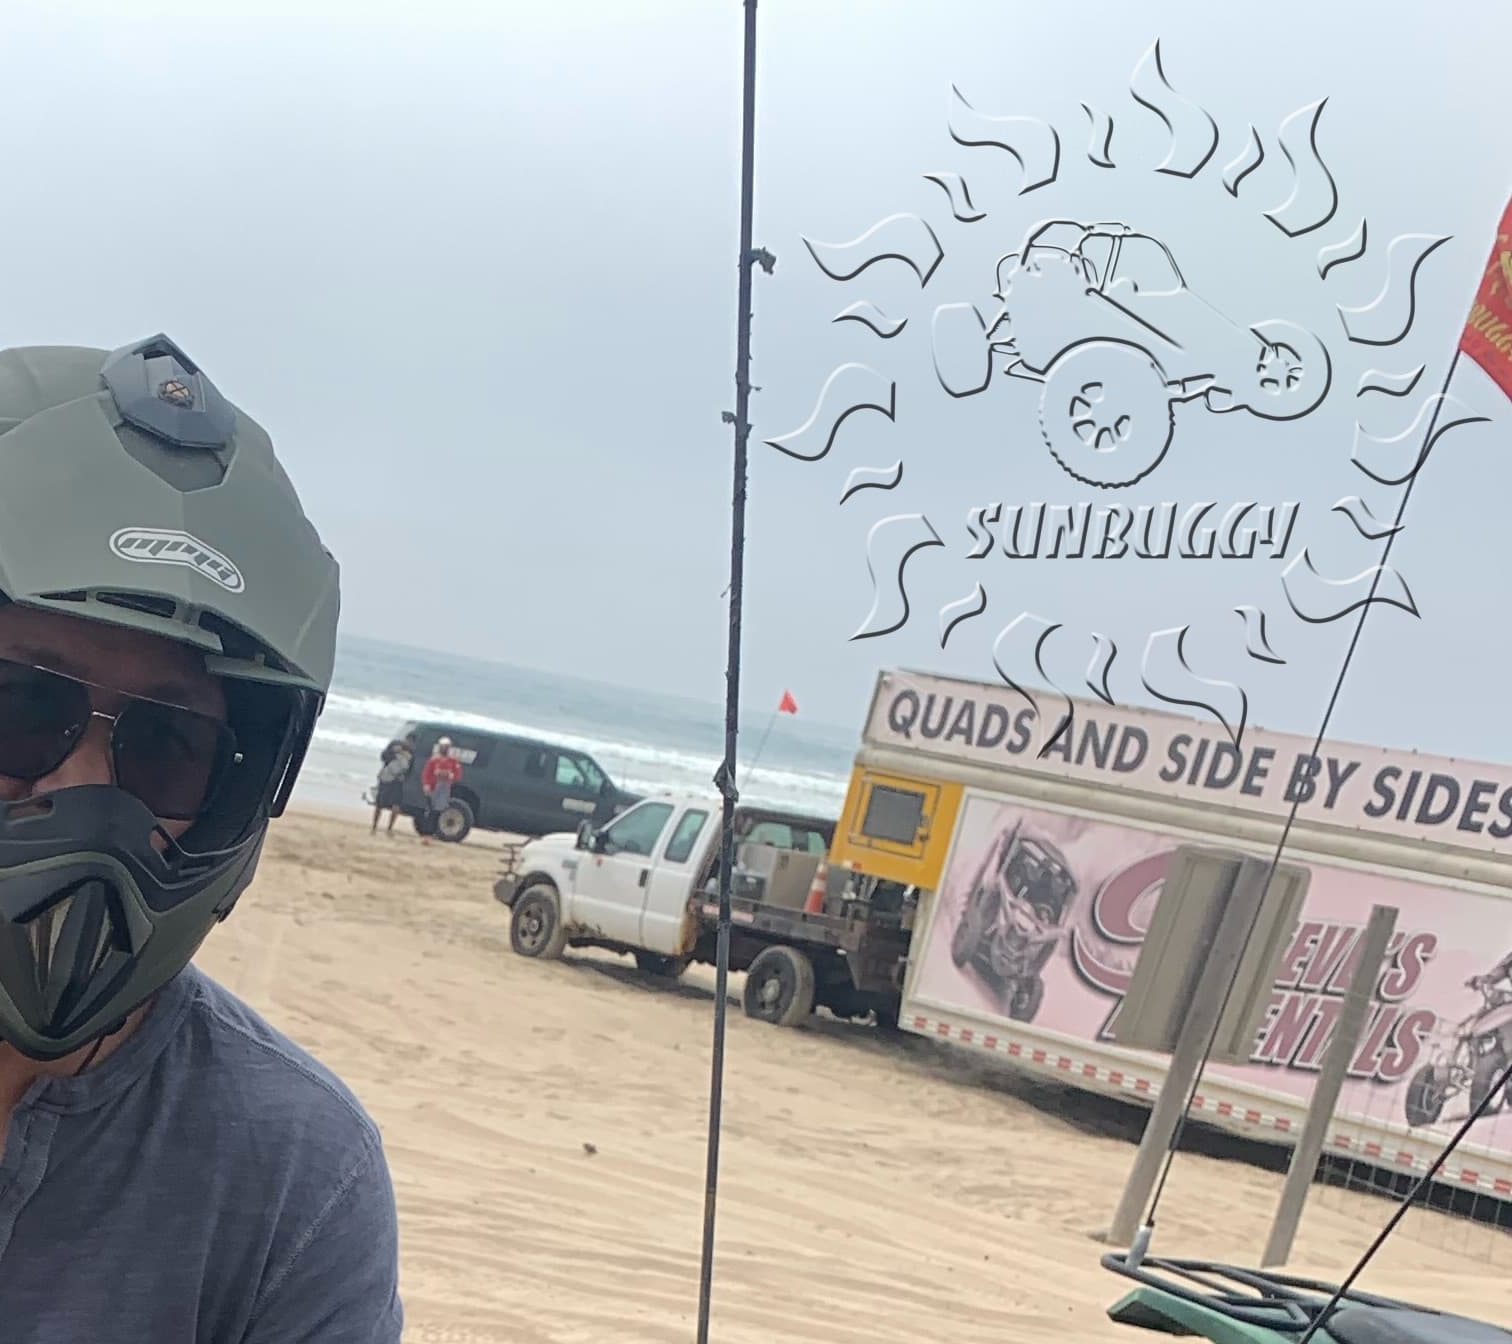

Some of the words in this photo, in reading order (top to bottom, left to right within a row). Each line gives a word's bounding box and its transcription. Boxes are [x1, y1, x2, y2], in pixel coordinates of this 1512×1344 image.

[887, 688, 1037, 754] QUADS
[1041, 713, 1149, 773] AND
[1159, 733, 1276, 797] SIDE
[1283, 752, 1361, 809] BY
